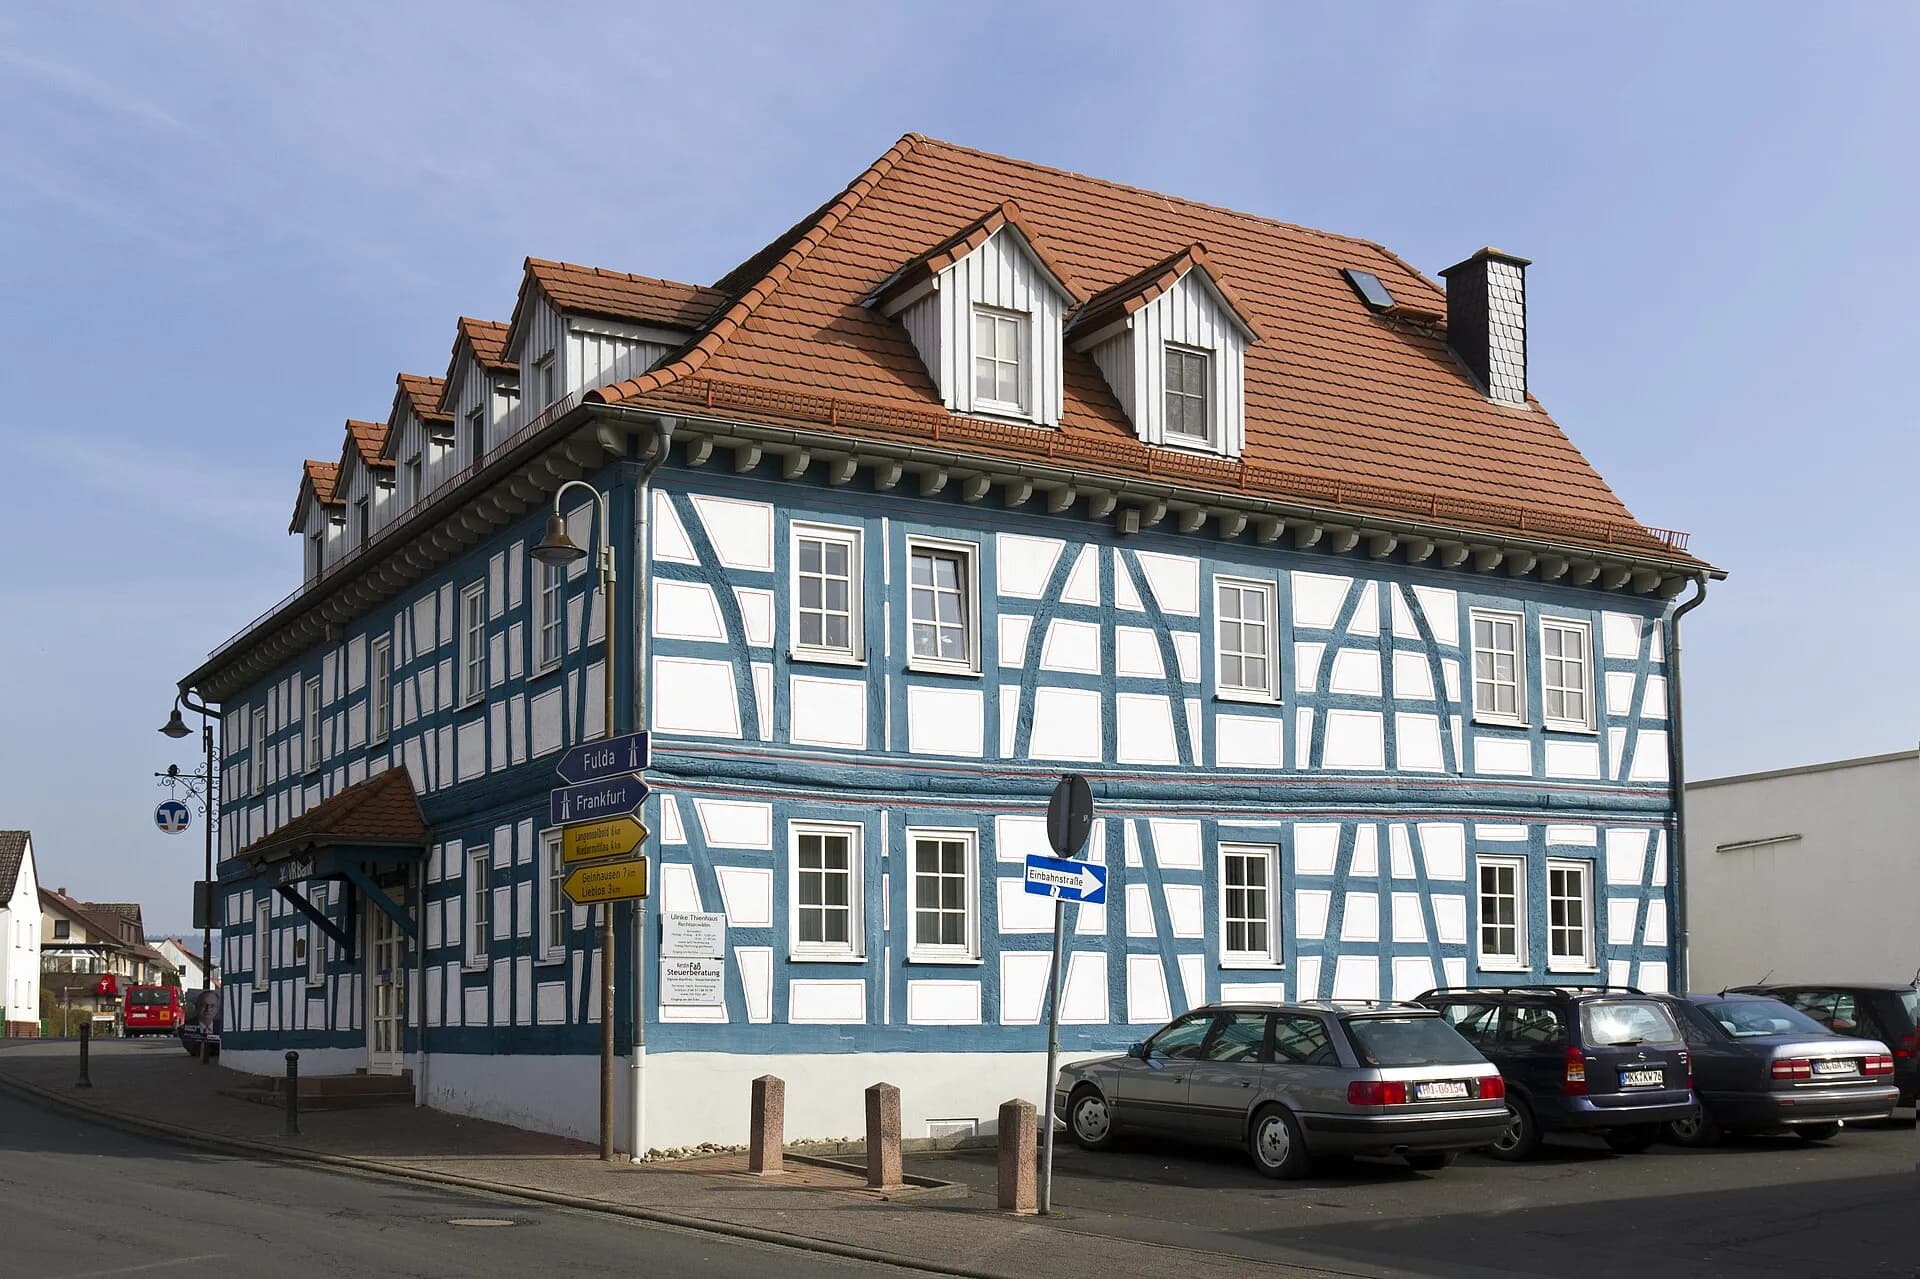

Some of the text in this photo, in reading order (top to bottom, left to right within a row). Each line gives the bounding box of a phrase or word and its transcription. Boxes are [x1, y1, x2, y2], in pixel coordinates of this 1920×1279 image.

[584, 749, 615, 771] Fulda
[576, 788, 626, 812] Frankfurt
[582, 870, 621, 883] Gelnhausen
[1029, 869, 1084, 886] Einbahnstraße
[582, 886, 605, 898] Lieblos
[667, 969, 720, 977] Steuerberatung
